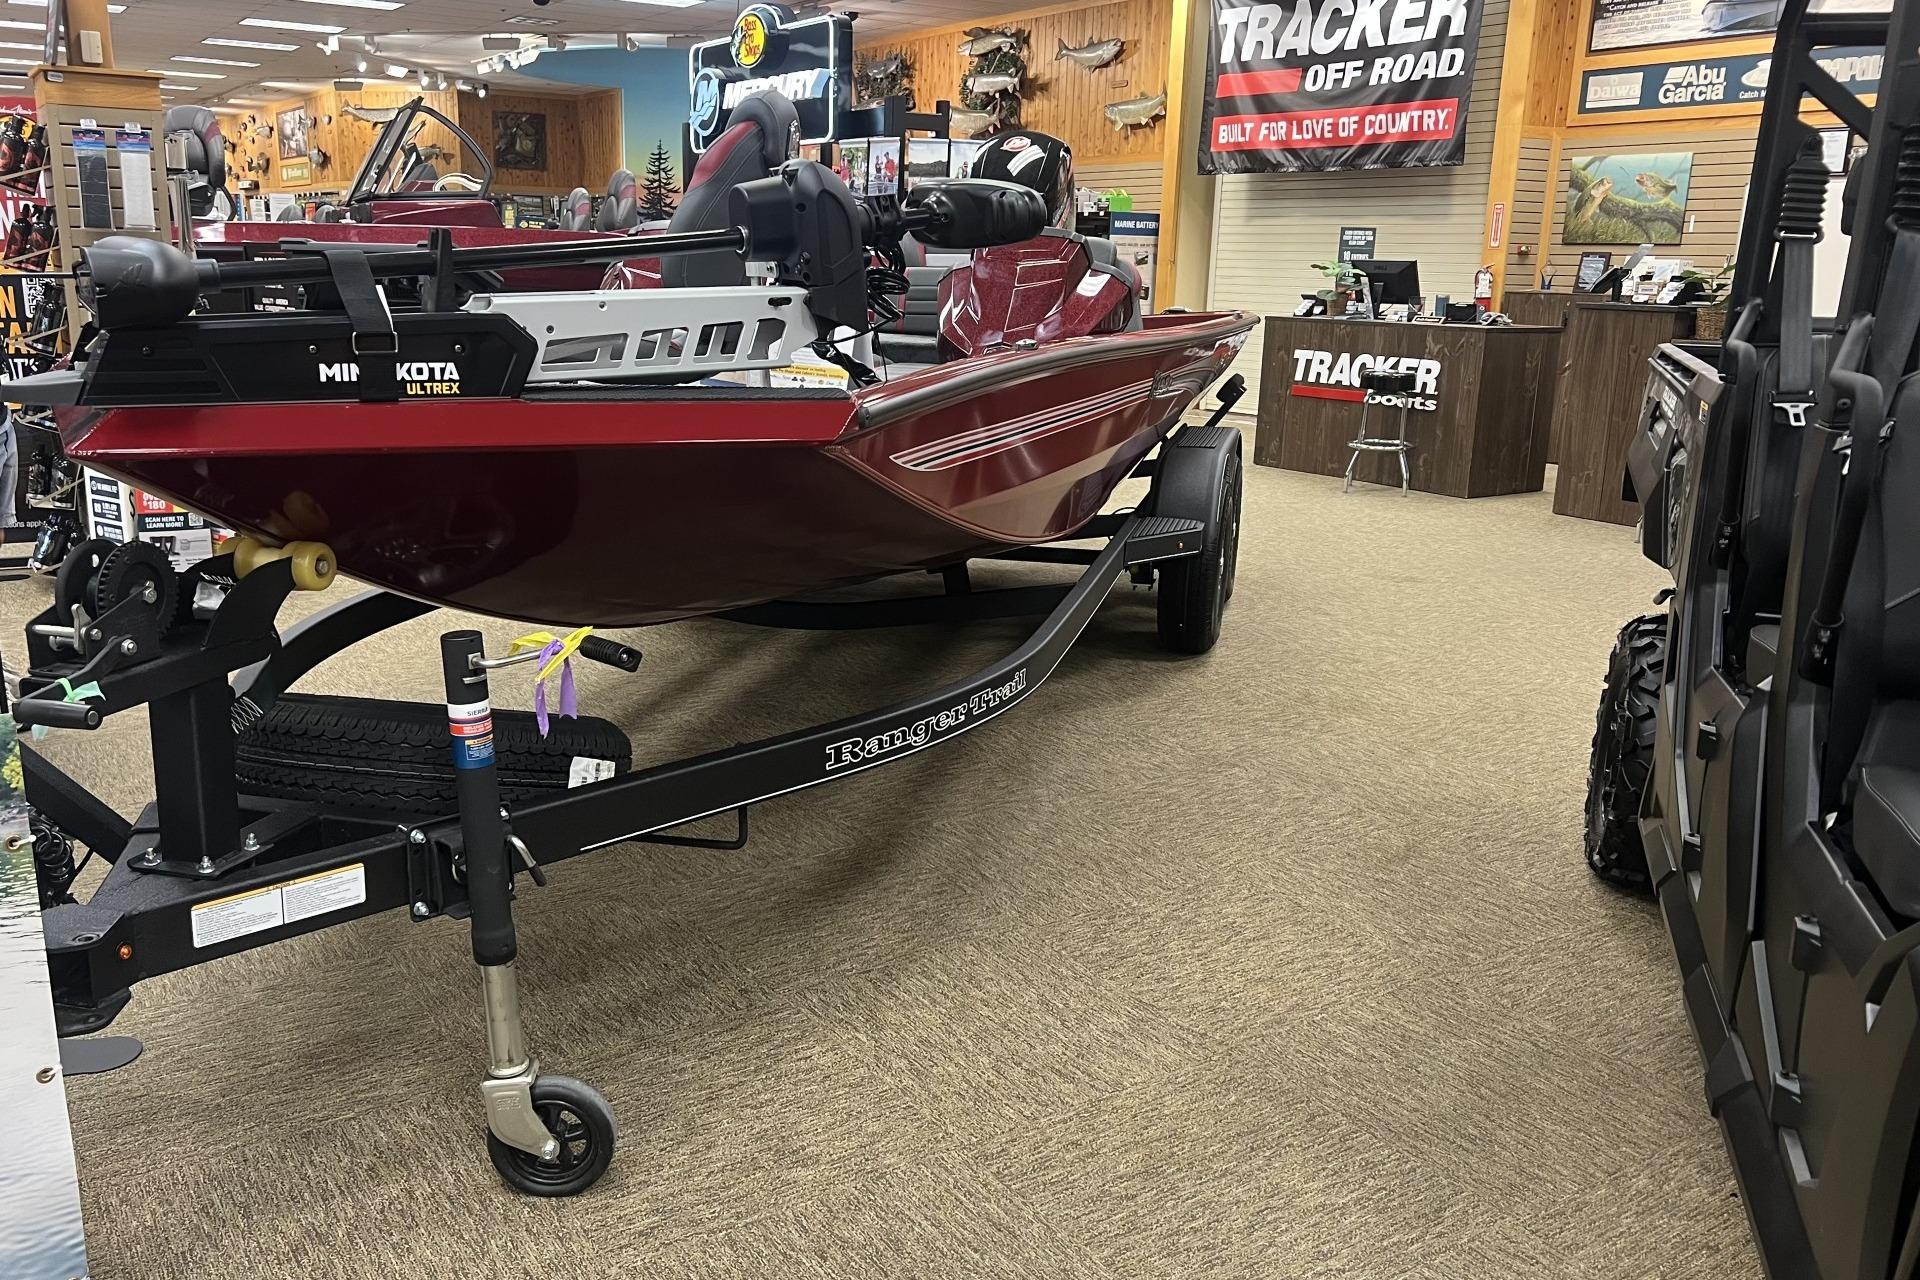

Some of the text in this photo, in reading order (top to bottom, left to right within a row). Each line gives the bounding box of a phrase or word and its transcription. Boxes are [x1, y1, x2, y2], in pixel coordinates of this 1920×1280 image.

[744, 18, 757, 29] Bass
[1218, 0, 1468, 64] TRACKER
[745, 33, 755, 45] Pro
[744, 44, 761, 59] Shops
[1304, 47, 1465, 92] OFF ROAD.
[1683, 64, 1726, 86] Abu
[1658, 82, 1727, 105] Garcia
[1739, 90, 1760, 99] Catch
[1218, 122, 1254, 144] BUILT
[1258, 120, 1287, 141] FOR
[1291, 117, 1334, 140] LOVE
[1338, 115, 1359, 138] OF
[1114, 220, 1136, 228] MARINE
[318, 362, 460, 382] MIN KOTA
[406, 382, 460, 395] ULTREX
[143, 500, 166, 510] $180
[825, 668, 1027, 770] Ranger Trail
